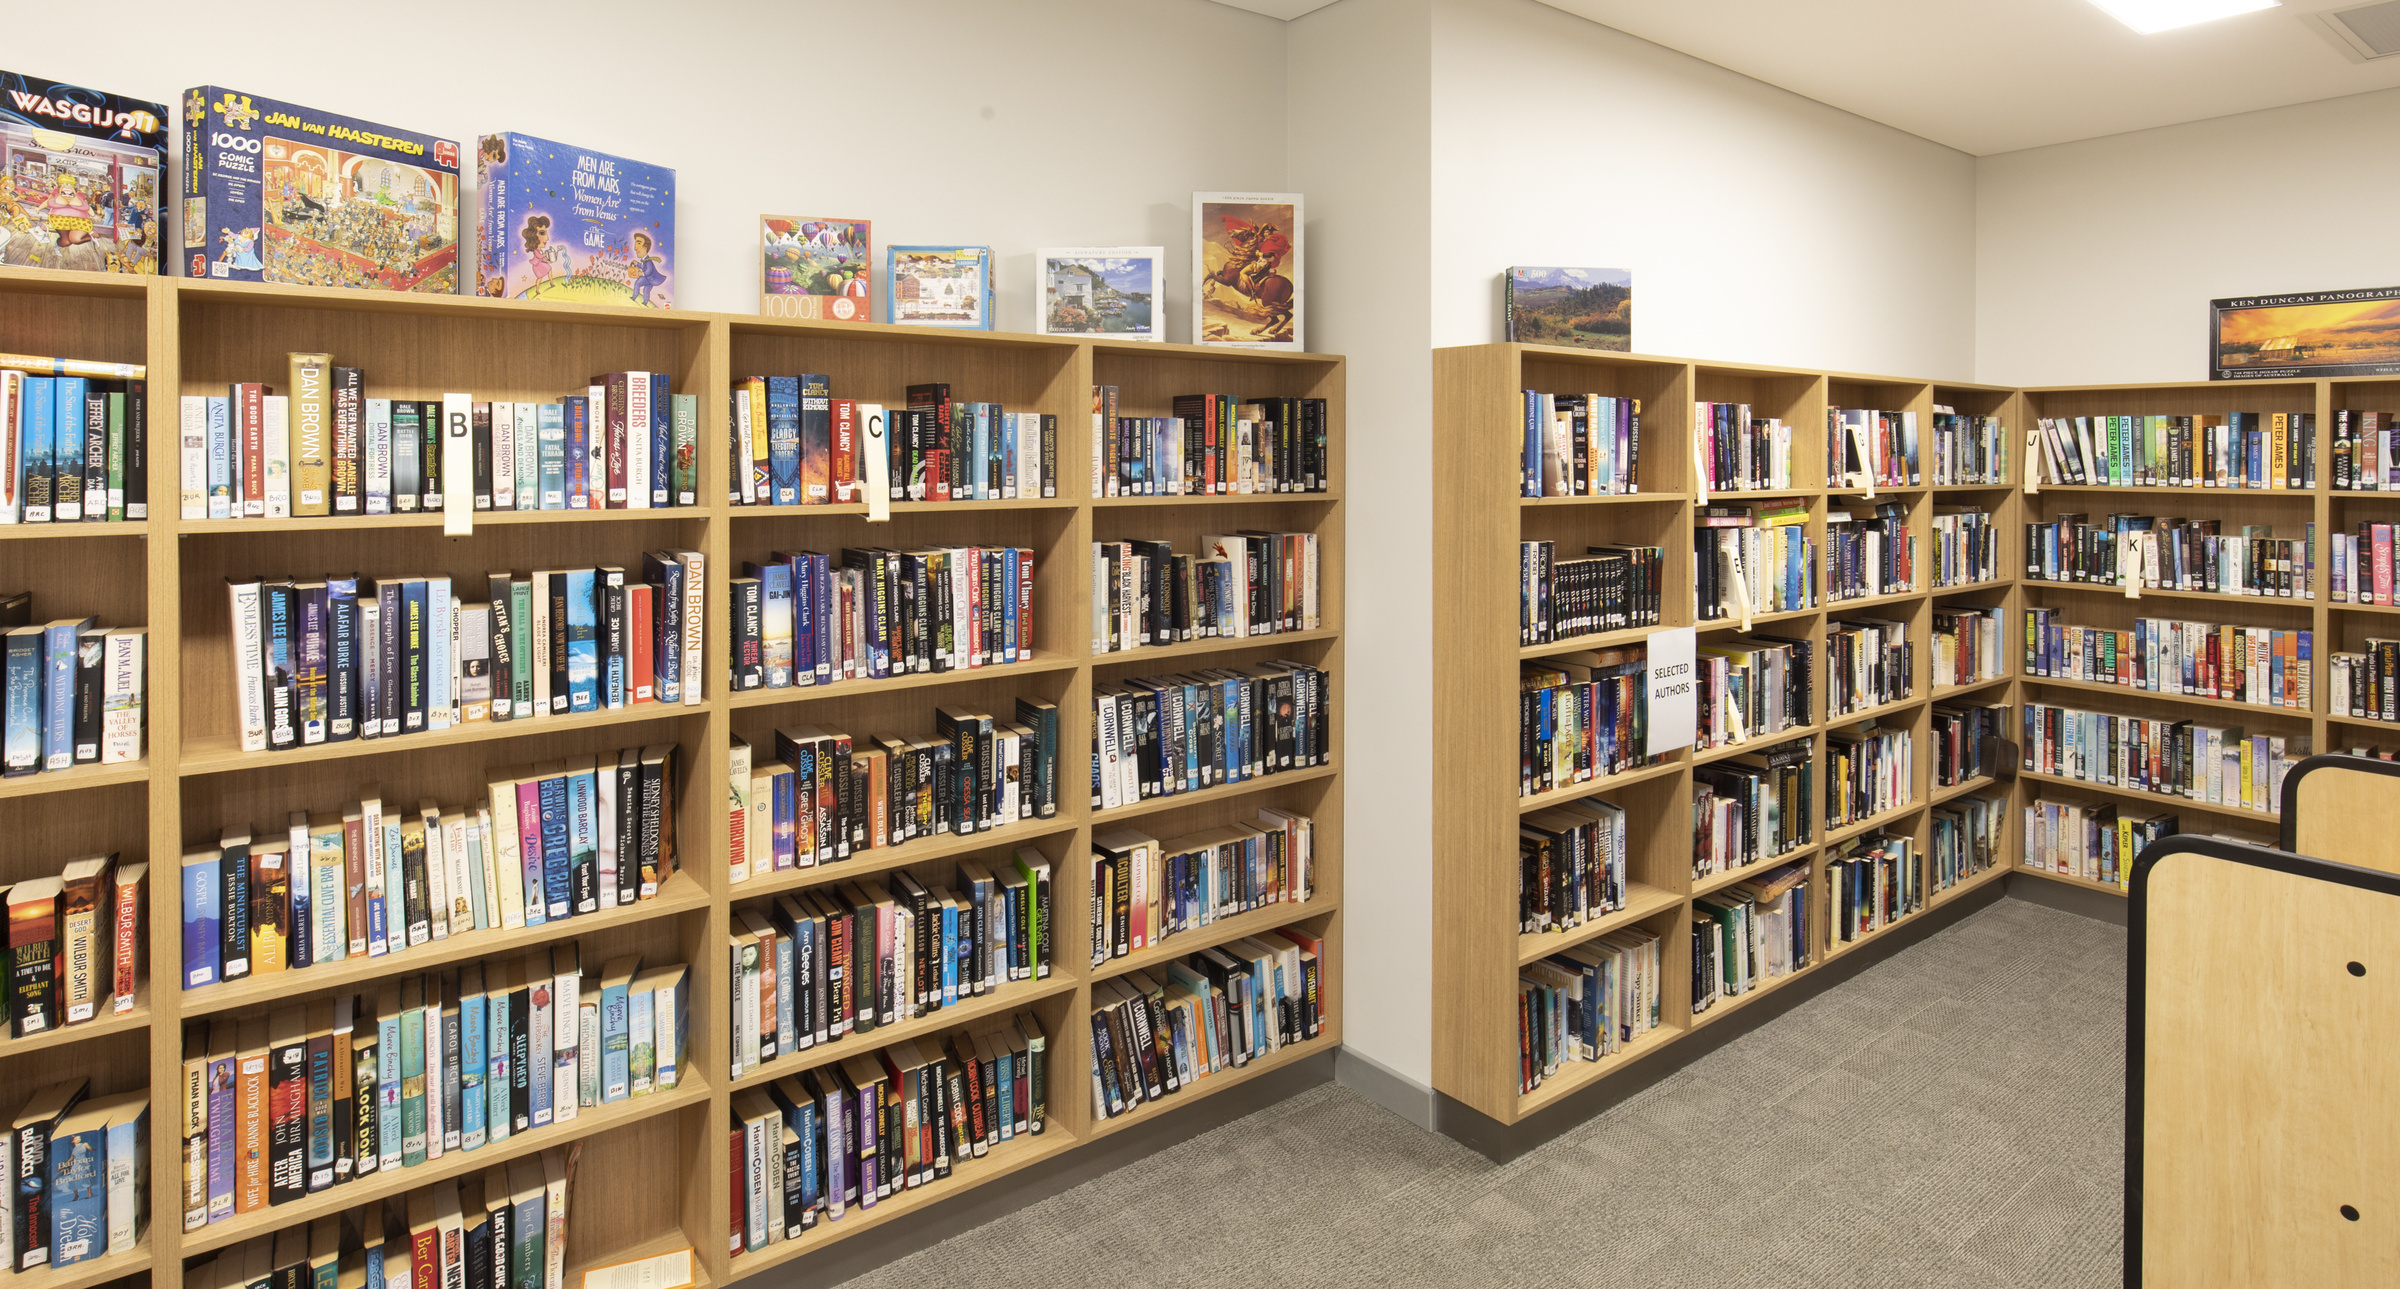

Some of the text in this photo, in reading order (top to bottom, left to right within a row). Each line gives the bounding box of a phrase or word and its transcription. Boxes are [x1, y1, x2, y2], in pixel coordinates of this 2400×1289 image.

[134, 112, 154, 133] 11
[212, 132, 262, 154] 1000
[264, 112, 424, 156] JAN VAN HAASTEREN
[219, 152, 254, 164] COMIC
[219, 160, 254, 173] PUZZLE
[578, 154, 615, 177] MEN ARE
[570, 184, 602, 206] Women
[602, 195, 622, 208] Are
[572, 170, 621, 195] FROM MARS,
[572, 204, 617, 222] from Venus
[584, 232, 605, 248] GAME
[1531, 270, 1547, 278] 500
[765, 295, 812, 319] 1000
[2260, 296, 2314, 305] DUNCAN
[65, 396, 76, 411] Sins
[66, 380, 76, 395] The
[632, 377, 647, 428] BREEDERS
[65, 420, 76, 432] the
[88, 399, 103, 468] JEFFREY ARCHER
[212, 401, 224, 429] ANITA
[301, 368, 320, 458] DAN BROWN
[336, 389, 347, 458] WAS EVERYTHING
[347, 372, 357, 459] ALL WE EVER WANTED
[450, 412, 468, 437] B
[839, 402, 851, 452] TOM CLANCY
[869, 414, 882, 439] C
[2339, 411, 2347, 437] THE SIGN
[2363, 418, 2376, 447] KING
[65, 433, 76, 456] Father
[213, 432, 224, 460] BURGH
[377, 422, 387, 478] DAN BROWN
[2028, 435, 2037, 446] J
[2110, 418, 2118, 468] PETER JAMES
[2275, 416, 2283, 468] PETER JAMES
[2130, 539, 2138, 551] K
[433, 588, 446, 638] Liz Byrski
[687, 560, 702, 651] DAN BROWN
[746, 585, 758, 637] TOM CLANCY
[875, 558, 887, 642] MARY HIGGINS CLARK
[238, 592, 258, 668] ENDLESS TIME
[271, 591, 287, 664] JAMES LEE BURKE
[337, 604, 349, 668] ALAFAIR BURKE
[385, 606, 394, 644] Geography
[493, 599, 510, 664] SATAN'S CHOICE
[115, 638, 133, 692] JEAN M. AUEL
[386, 646, 394, 654] of
[2104, 635, 2115, 667] KELLERMAN
[2235, 635, 2245, 670] OBSESSION
[2259, 642, 2269, 663] MOTIVE
[1655, 663, 1688, 680] SELECTED
[1655, 683, 1690, 699] AUTHORS
[274, 686, 288, 729] RAIN GODS
[339, 671, 347, 716] MISSING JUSTICE
[2384, 694, 2394, 712] KILLERS
[1104, 706, 1116, 755] CORNWELL
[1122, 703, 1134, 750] CORNWELL
[576, 779, 588, 844] LINWOOD BARCLAY
[524, 833, 540, 871] Desire
[730, 808, 745, 865] WHIRLWIND
[195, 871, 207, 908] GOSPEL
[1116, 860, 1129, 902] COULTER
[227, 873, 236, 942] JESSIE BURTON
[237, 857, 245, 951] THE MINIATURIST
[120, 886, 133, 965] WILBUR SMITH
[831, 920, 842, 966] JON CLEARY
[74, 936, 87, 1000] WILBUR SMITH
[801, 945, 811, 986] Cleeves
[1307, 966, 1316, 1004] COVENANT
[1134, 1004, 1151, 1050] CORNWELL
[191, 1071, 200, 1129] ETHAN BLACK
[313, 1051, 329, 1159] PATRICK BISHOP
[971, 1103, 984, 1139] OUTBREAK
[21, 1128, 33, 1178] BALDACCI
[274, 1159, 288, 1187] AFTER
[288, 1148, 303, 1189] AMERICA
[752, 1125, 761, 1194] Harlan COBEN
